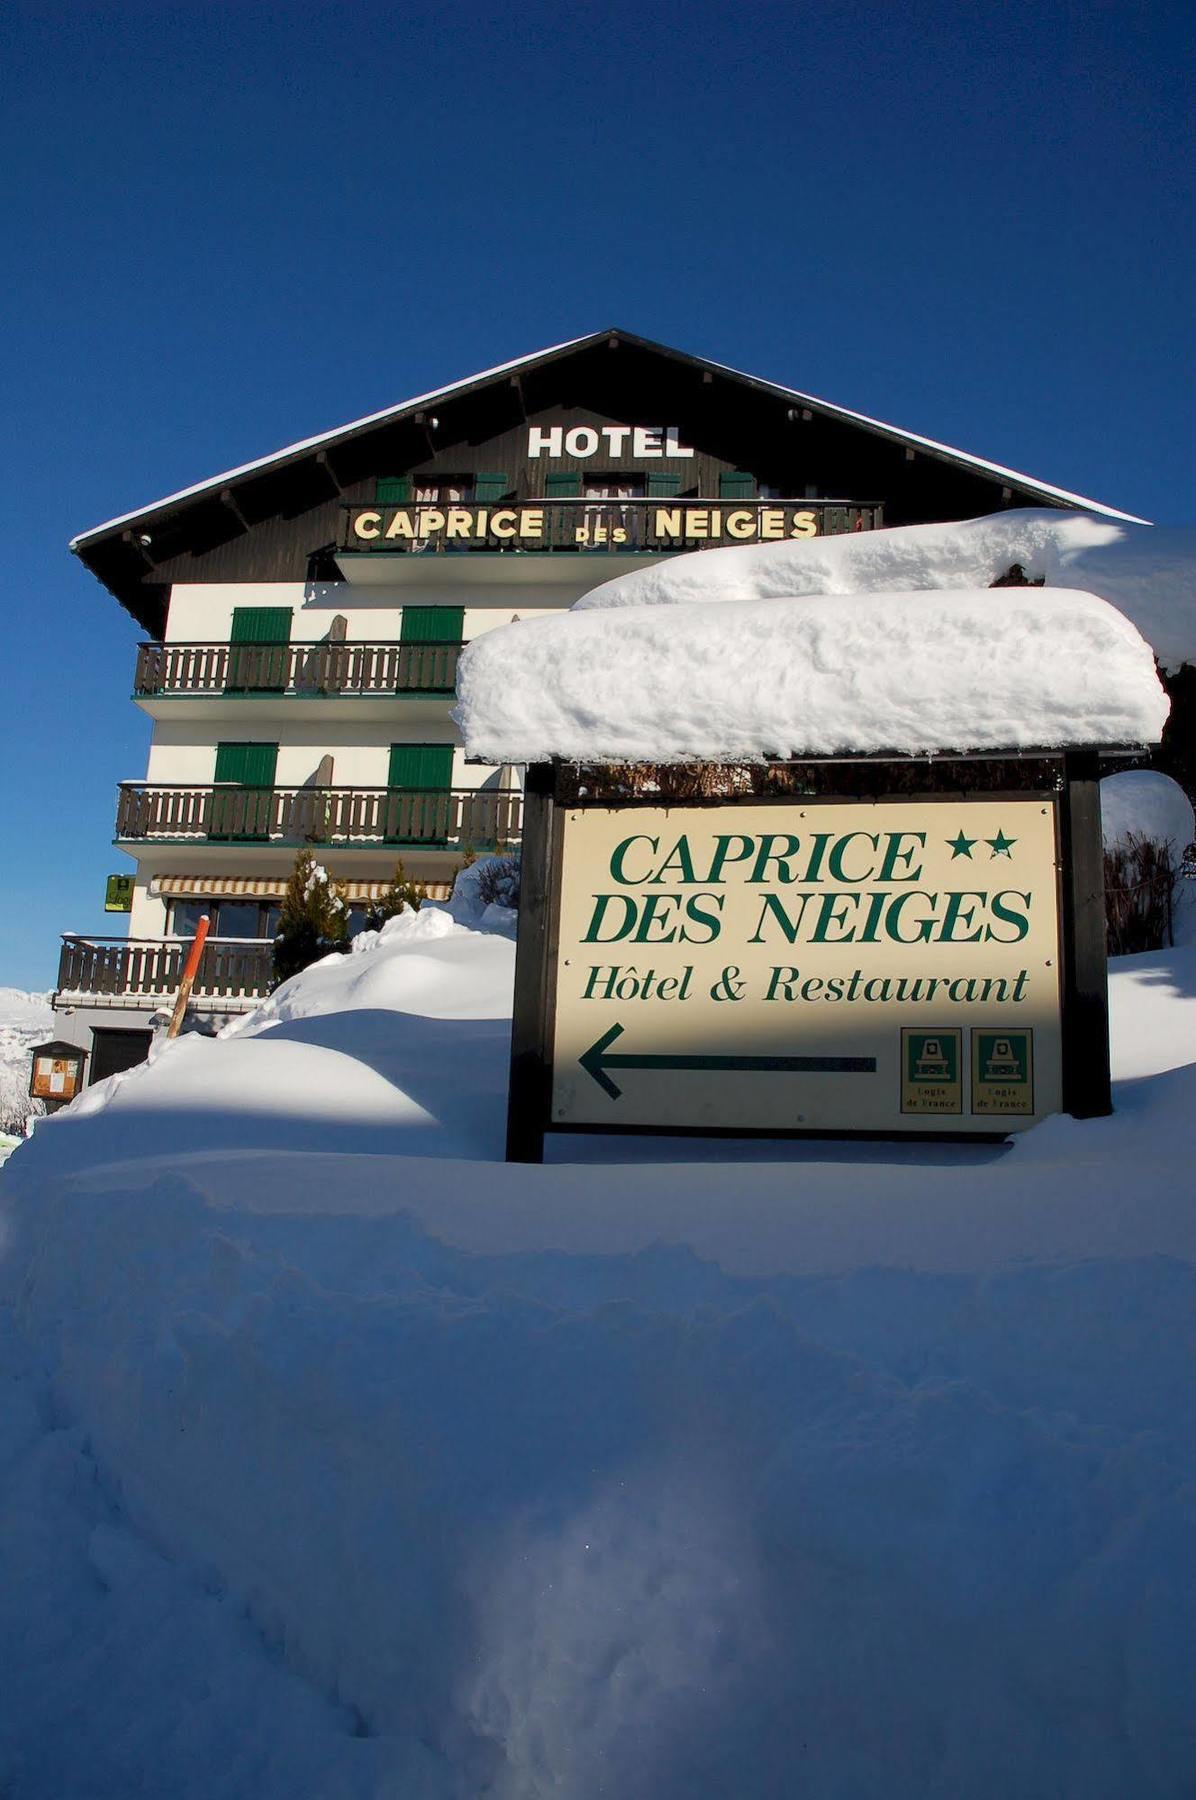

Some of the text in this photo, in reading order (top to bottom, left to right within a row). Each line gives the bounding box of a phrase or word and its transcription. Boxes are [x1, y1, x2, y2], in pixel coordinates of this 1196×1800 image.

[528, 426, 695, 458] HOTEL
[354, 508, 819, 543] CAPRICE DES NEIGES
[610, 832, 926, 885] CAPRICE
[579, 890, 1032, 944] DES NEIGES
[581, 965, 1030, 1002] Hôtel & Restaurant
